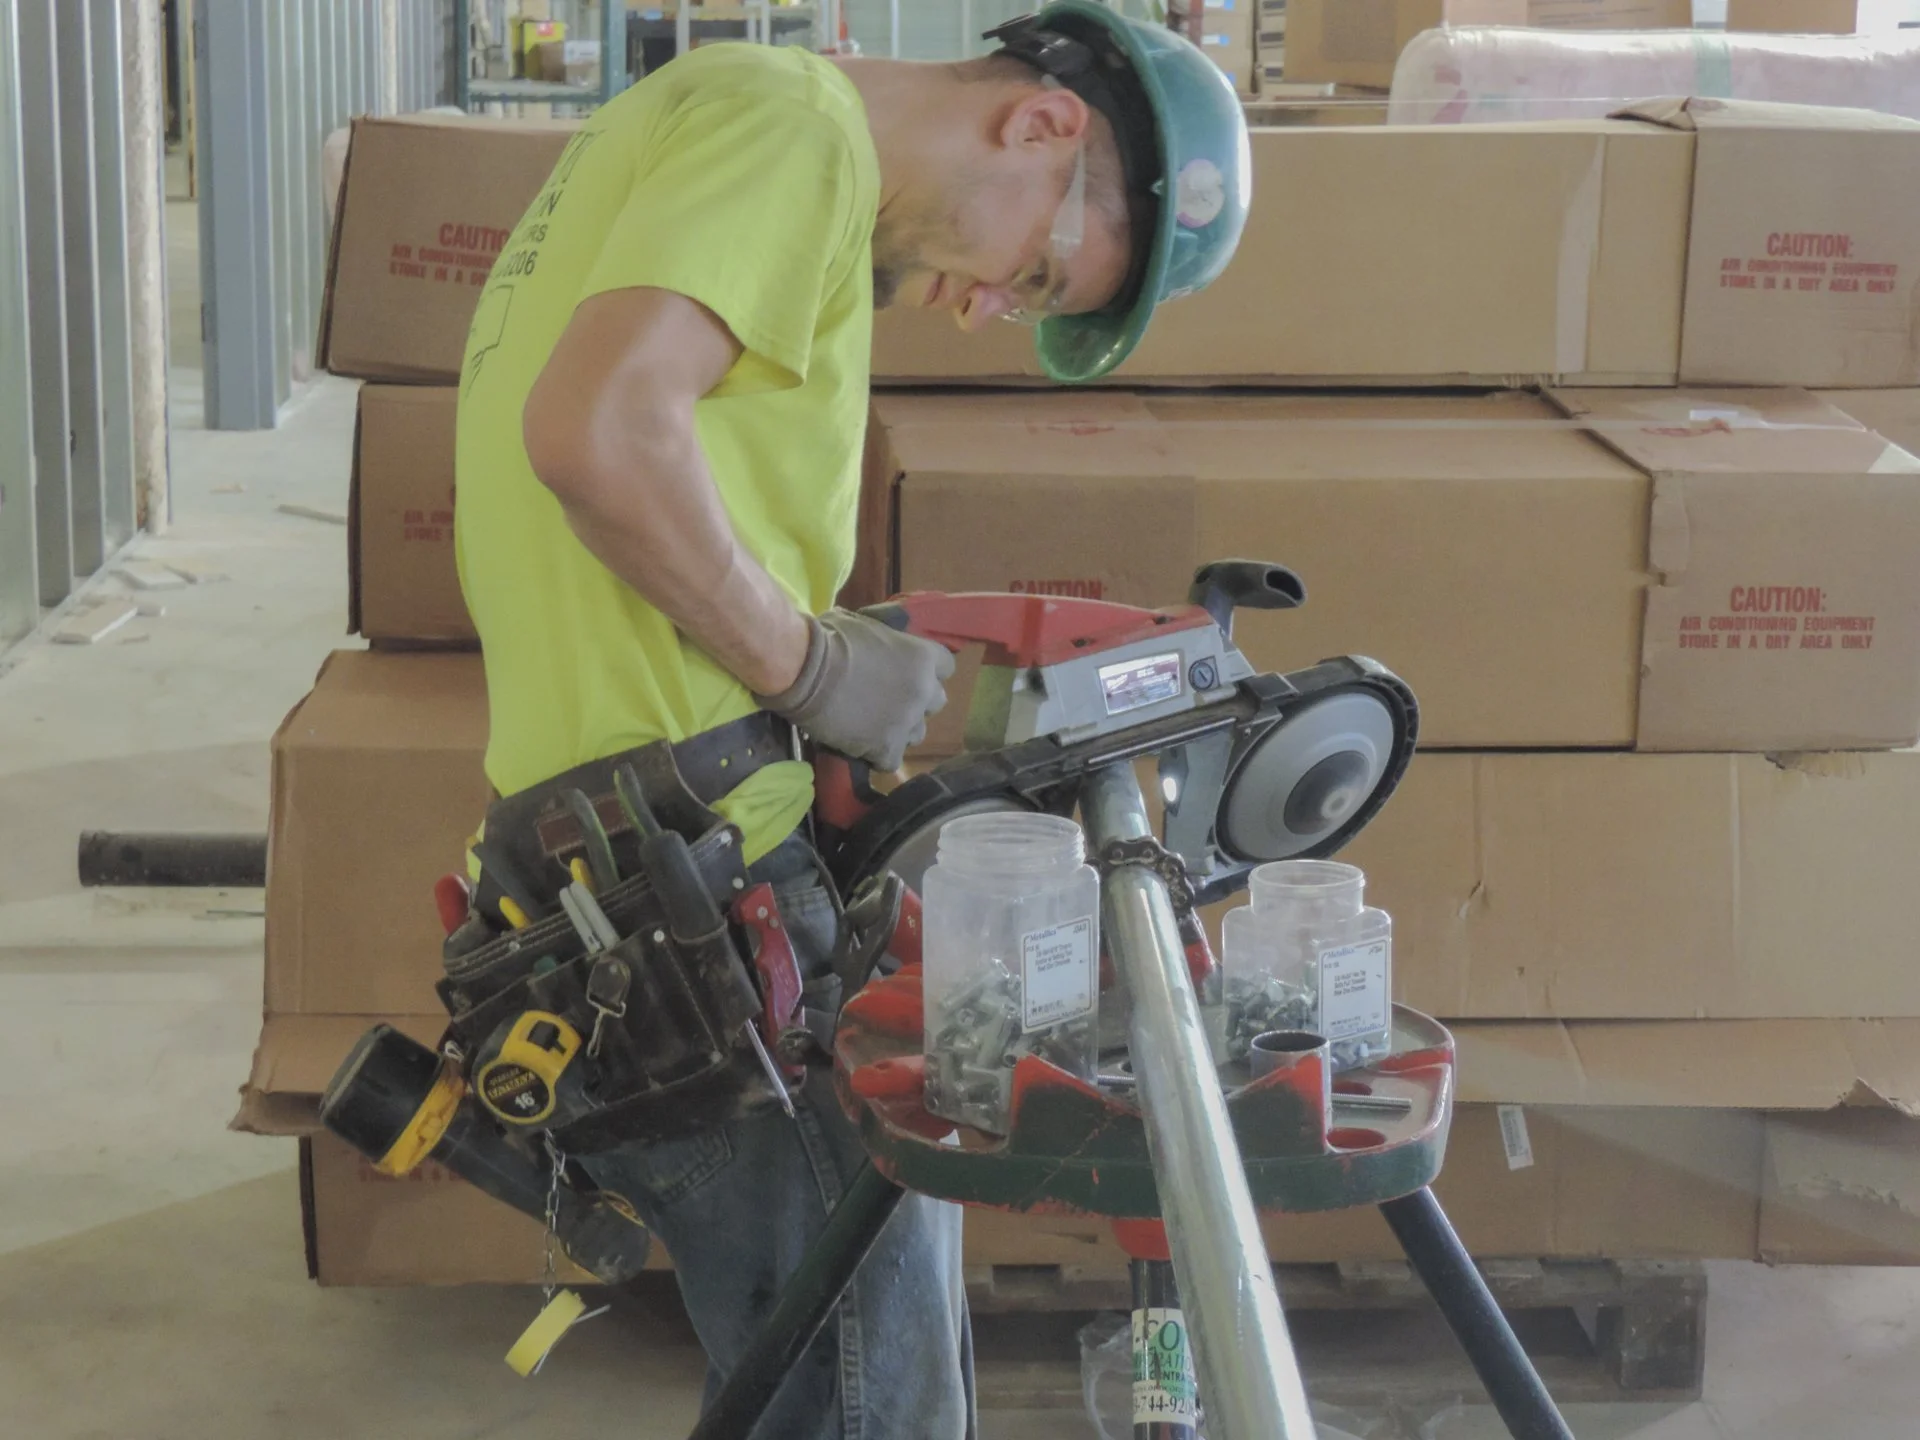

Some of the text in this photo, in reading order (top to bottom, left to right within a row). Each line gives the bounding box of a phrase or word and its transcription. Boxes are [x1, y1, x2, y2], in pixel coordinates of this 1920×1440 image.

[1767, 232, 1853, 258] CAUTION:
[1730, 586, 1827, 612] CAUTION:
[1680, 617, 1875, 631] AIR CONDITIONING EQUIPMENT
[1679, 634, 1873, 649] STORE IN A DRY AREA ONLY
